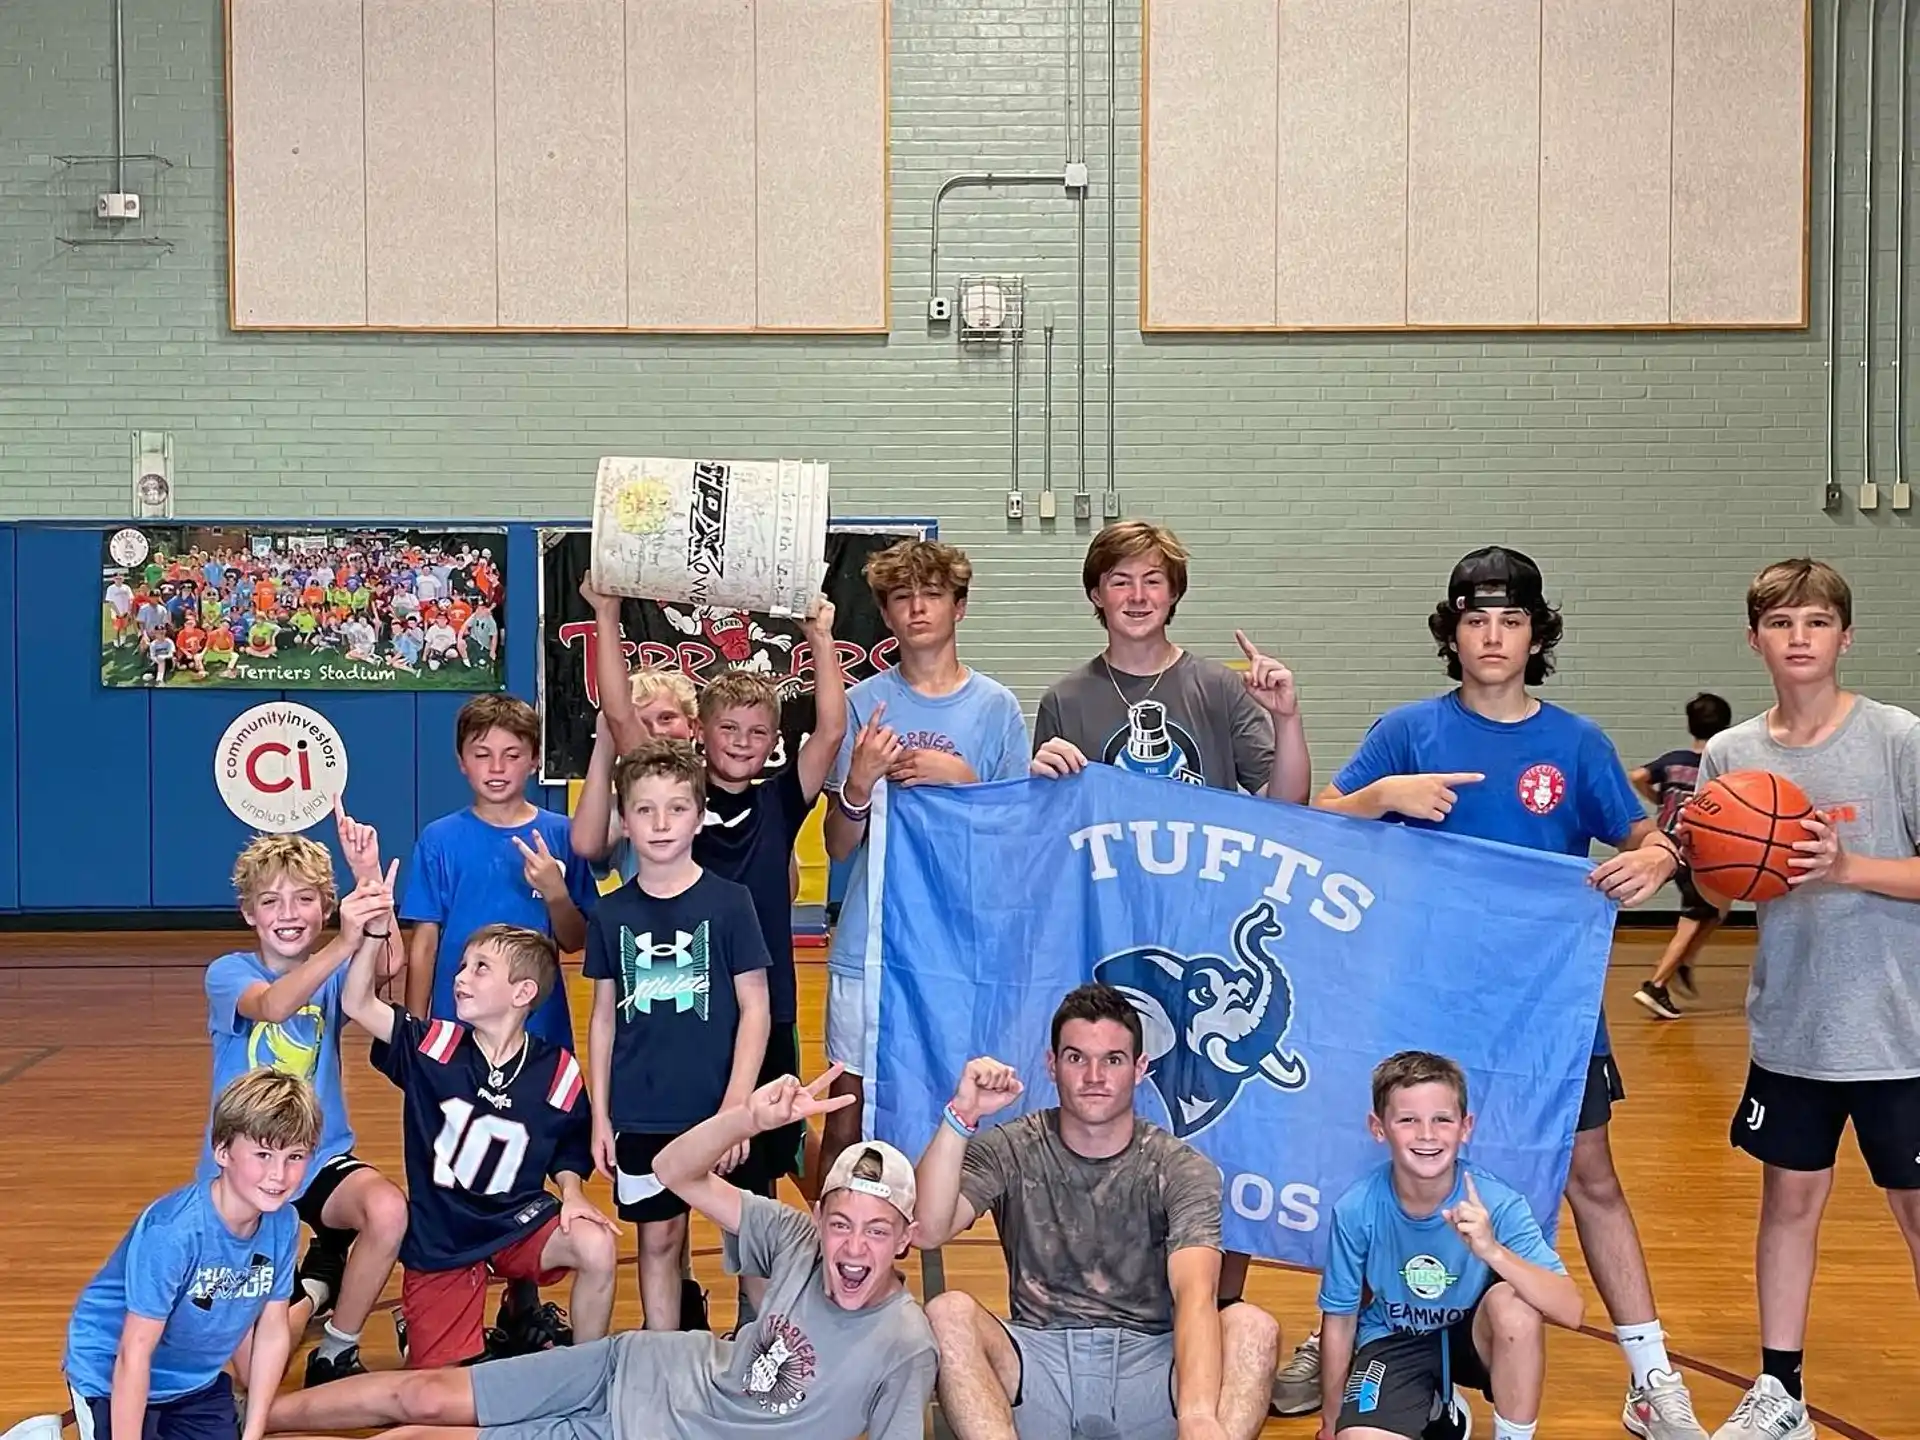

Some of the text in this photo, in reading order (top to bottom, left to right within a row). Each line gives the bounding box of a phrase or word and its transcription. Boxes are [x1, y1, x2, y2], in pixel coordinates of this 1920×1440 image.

[237, 663, 396, 681] Terriers Stadium
[241, 791, 333, 826] unplug & play
[1068, 820, 1376, 933] TUFTS
[433, 1097, 531, 1195] 10
[1217, 1165, 1321, 1233] OS
